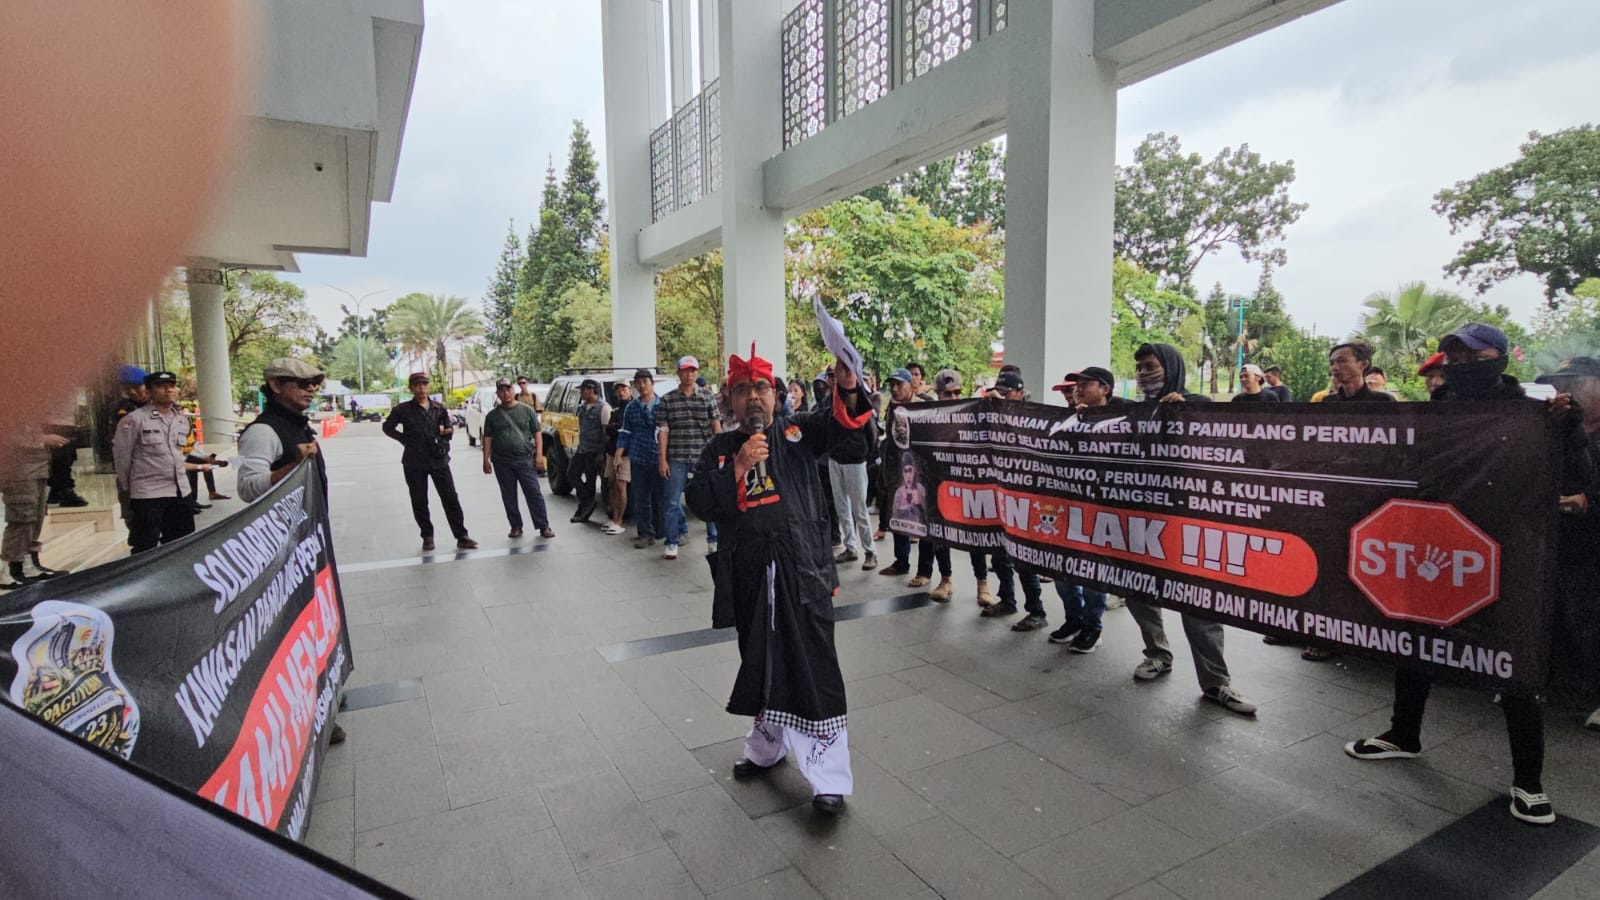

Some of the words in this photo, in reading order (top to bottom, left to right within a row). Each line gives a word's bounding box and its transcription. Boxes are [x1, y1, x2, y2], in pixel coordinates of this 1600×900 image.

[951, 412, 977, 426] RUKO,
[1138, 420, 1161, 434] RW
[1166, 421, 1184, 435] 23
[1189, 421, 1296, 440] PAMULANG
[1303, 425, 1396, 445] PERMAI
[1018, 434, 1074, 454] SELATAN,
[1078, 441, 1145, 460] BANTEN,
[1151, 443, 1246, 464] INDONESIA
[950, 466, 962, 477] RW
[963, 467, 975, 480] 23,
[1037, 476, 1083, 496] PERMAI
[1100, 486, 1174, 507] TANGSEL
[1188, 495, 1271, 520] BANTEN"
[955, 453, 989, 466] WARGA
[1055, 466, 1100, 484] RUKO,
[1104, 471, 1207, 493] PERUMAHAN
[1212, 481, 1225, 495] &
[1231, 482, 1325, 508] KULINER
[193, 509, 290, 614] SOLIDARITAS
[929, 522, 943, 539] AREA
[959, 529, 1003, 548] DIJADIKAN
[1018, 543, 1063, 572] BERBAYAR
[1065, 556, 1095, 580] OLEH
[1097, 564, 1160, 600] WALIKOTA,
[1162, 579, 1212, 609] DISHUB
[1215, 591, 1245, 618] DAN
[1249, 599, 1299, 632] PIHAK
[1303, 612, 1413, 656] PEMENANG
[1419, 635, 1513, 679] LELANG
[175, 607, 257, 748] KAWASAN
[255, 551, 304, 642] PAMULANG
[86, 713, 107, 742] 23
